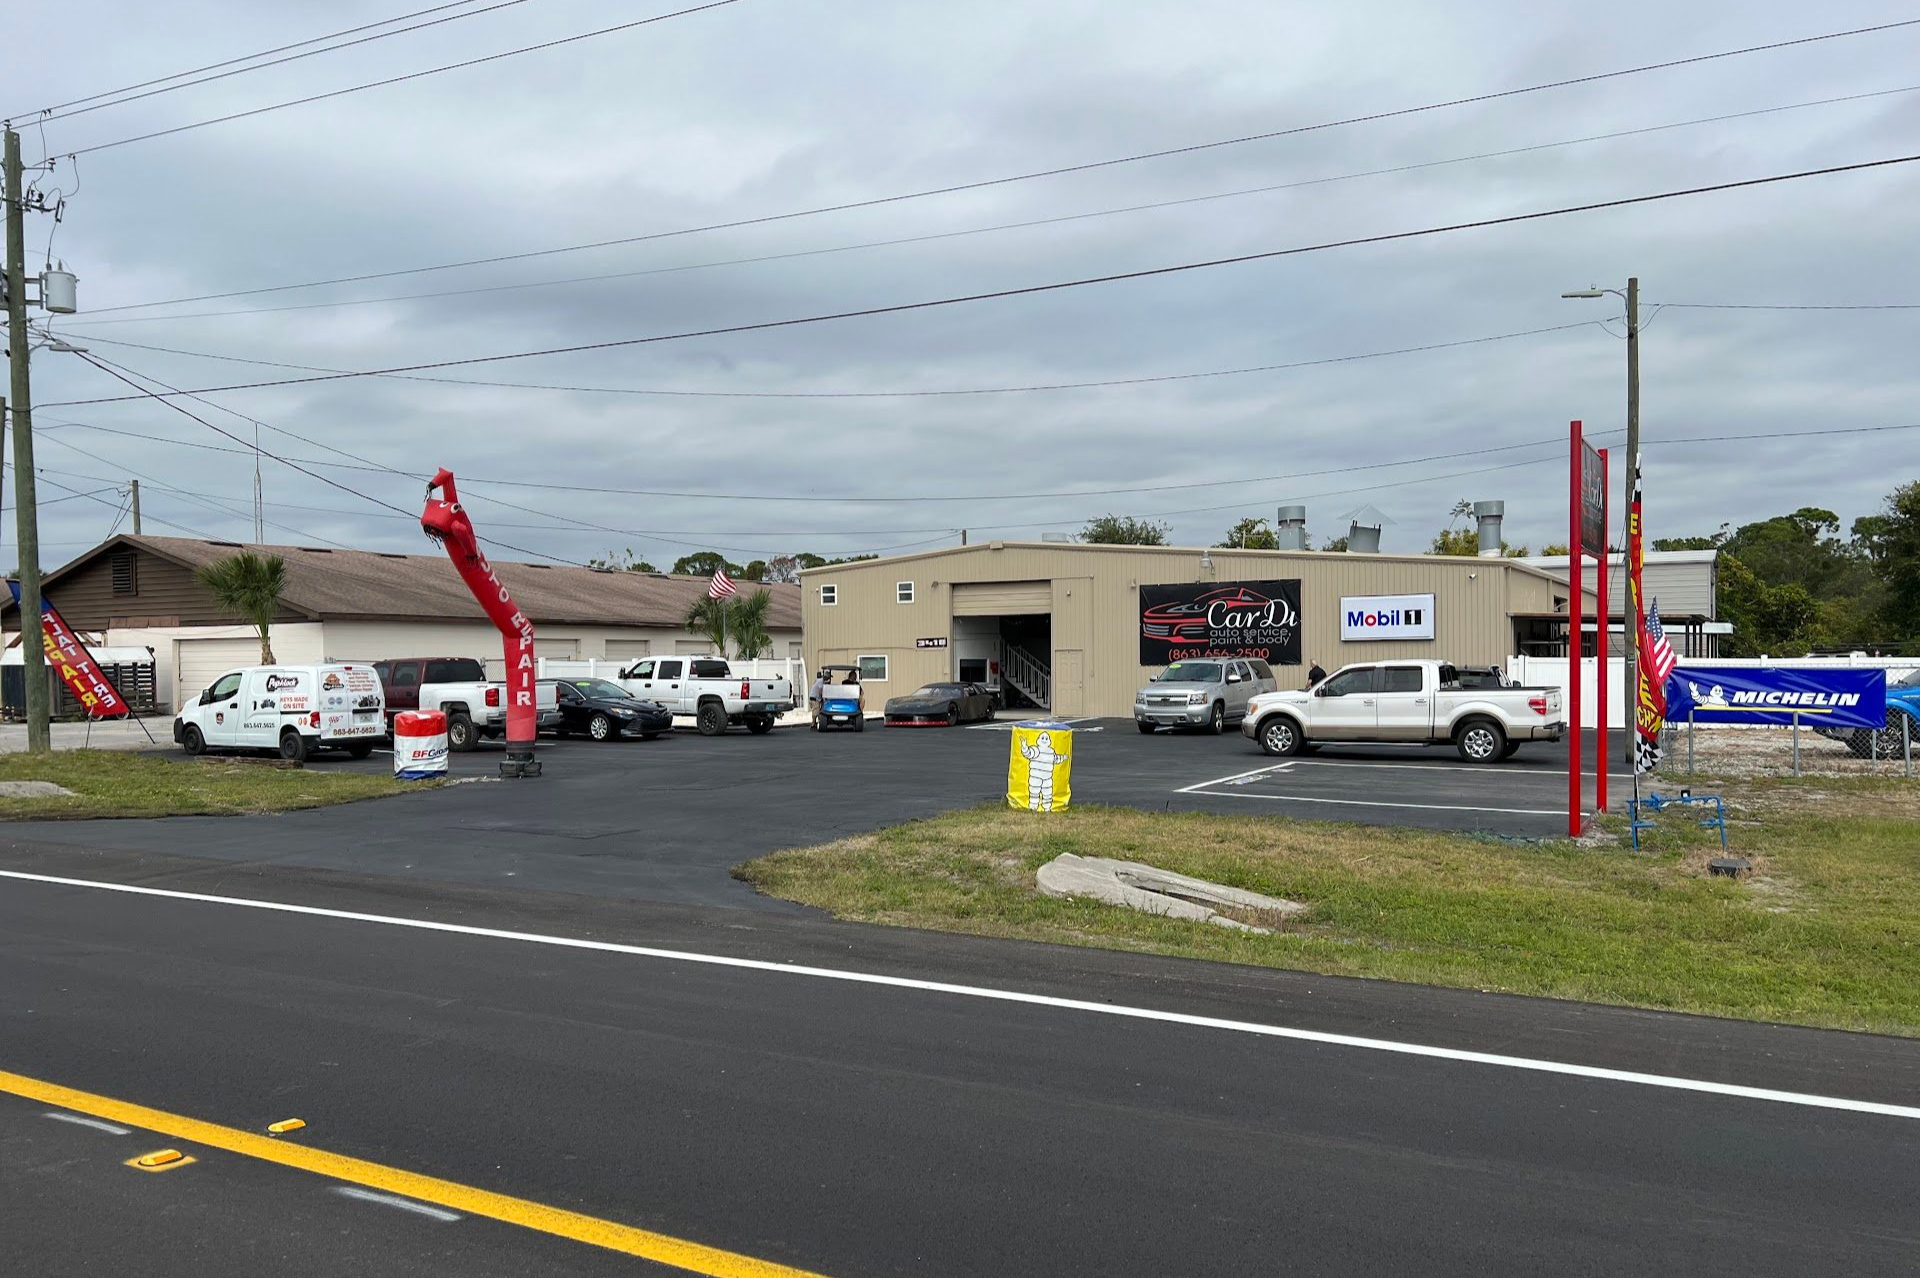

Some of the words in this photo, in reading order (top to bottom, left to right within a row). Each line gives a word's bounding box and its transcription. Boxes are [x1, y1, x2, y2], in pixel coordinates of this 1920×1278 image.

[1348, 610, 1400, 627] Mobil
[1210, 628, 1240, 637] auto
[1210, 635, 1242, 647] paint
[1245, 636, 1255, 645] &
[1258, 635, 1290, 645] body
[1168, 648, 1201, 661] (863)
[1204, 648, 1270, 659] 656-2500
[1732, 691, 1860, 706] MICHELIN
